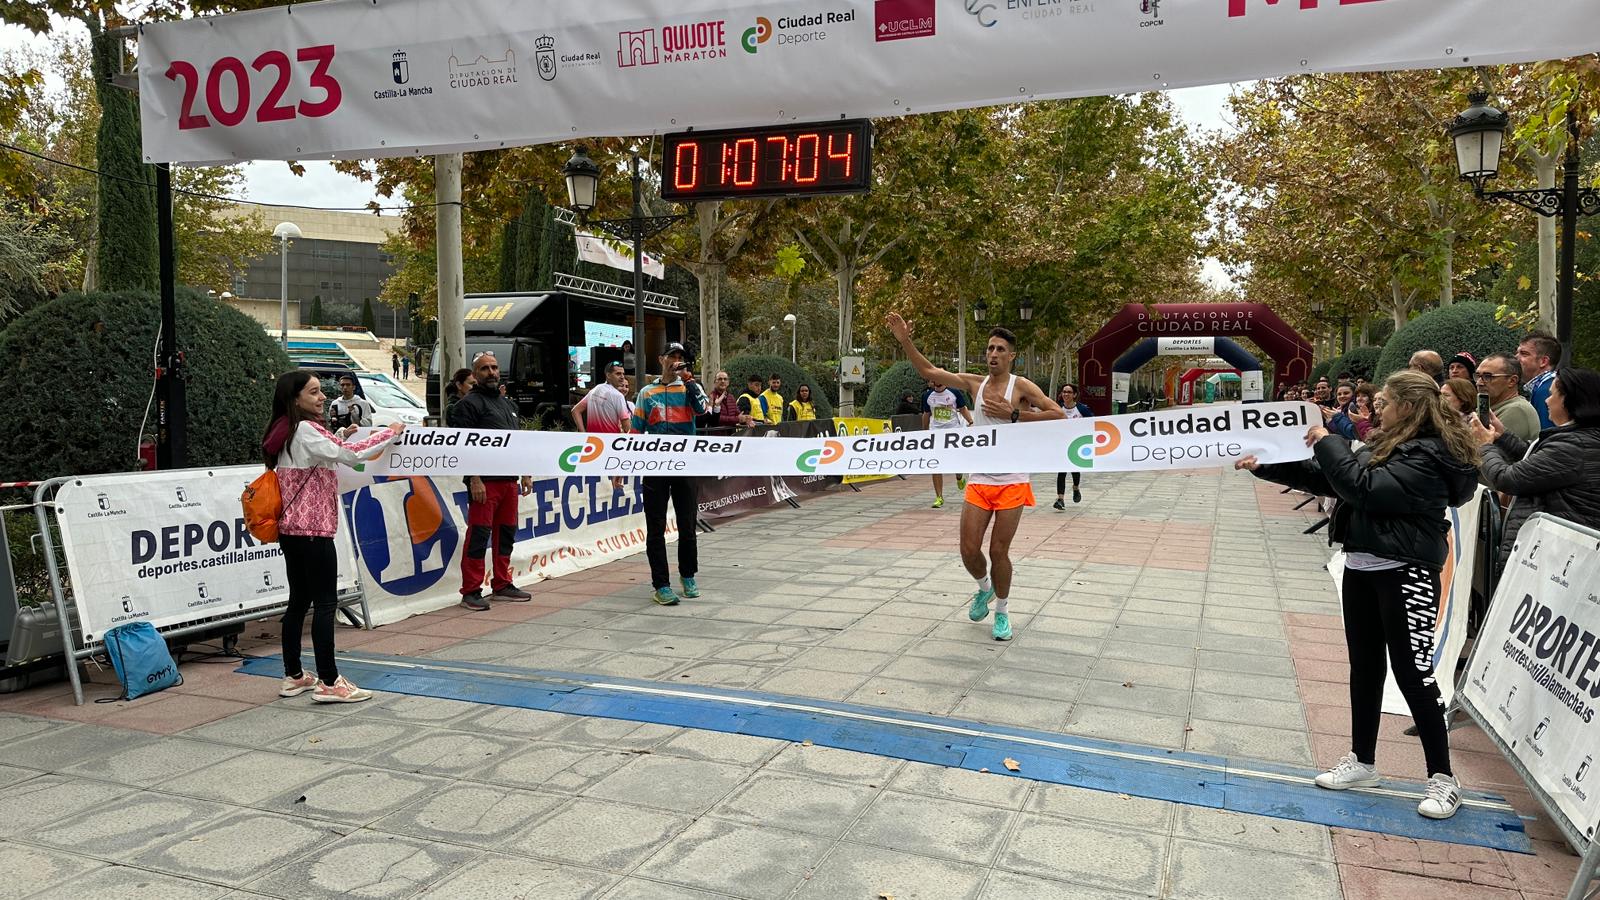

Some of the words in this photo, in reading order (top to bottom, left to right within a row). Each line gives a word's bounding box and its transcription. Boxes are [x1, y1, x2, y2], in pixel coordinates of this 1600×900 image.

[778, 13, 823, 30] Ciudad
[826, 9, 855, 24] Real
[1022, 8, 1062, 20] CIUDAD
[887, 17, 933, 32] UCLM
[1139, 20, 1164, 28] COPCM
[662, 20, 725, 52] QUIJOTE
[778, 30, 827, 45] Deporte
[560, 53, 585, 63] Ciudad
[585, 51, 601, 61] Real
[664, 47, 727, 64] MARATÓN
[164, 44, 342, 131] 2023
[450, 77, 490, 89] CIUDAD
[493, 74, 518, 85] REAL
[374, 88, 407, 100] Castilla-La
[408, 85, 433, 97] Mancha
[1138, 311, 1228, 320] DIUTACION
[1237, 311, 1253, 319] DE
[1137, 320, 1205, 331] CIUDAD
[1211, 320, 1252, 331] REAL
[1129, 410, 1231, 437] Ciudad
[1241, 405, 1307, 430] Real
[464, 432, 512, 448] Real
[611, 437, 688, 453] Ciudad
[693, 439, 742, 453] Real
[852, 433, 935, 453] Ciudad
[943, 429, 997, 449] Real
[1131, 441, 1242, 464] Deporte
[389, 453, 459, 472] Deporte
[604, 456, 686, 473] Deporte
[847, 456, 940, 472] Deporte
[698, 496, 733, 512] ESPECIALISTAS
[732, 494, 739, 503] EN
[739, 486, 767, 501] ANIMALES
[596, 528, 646, 554] CIUDAD
